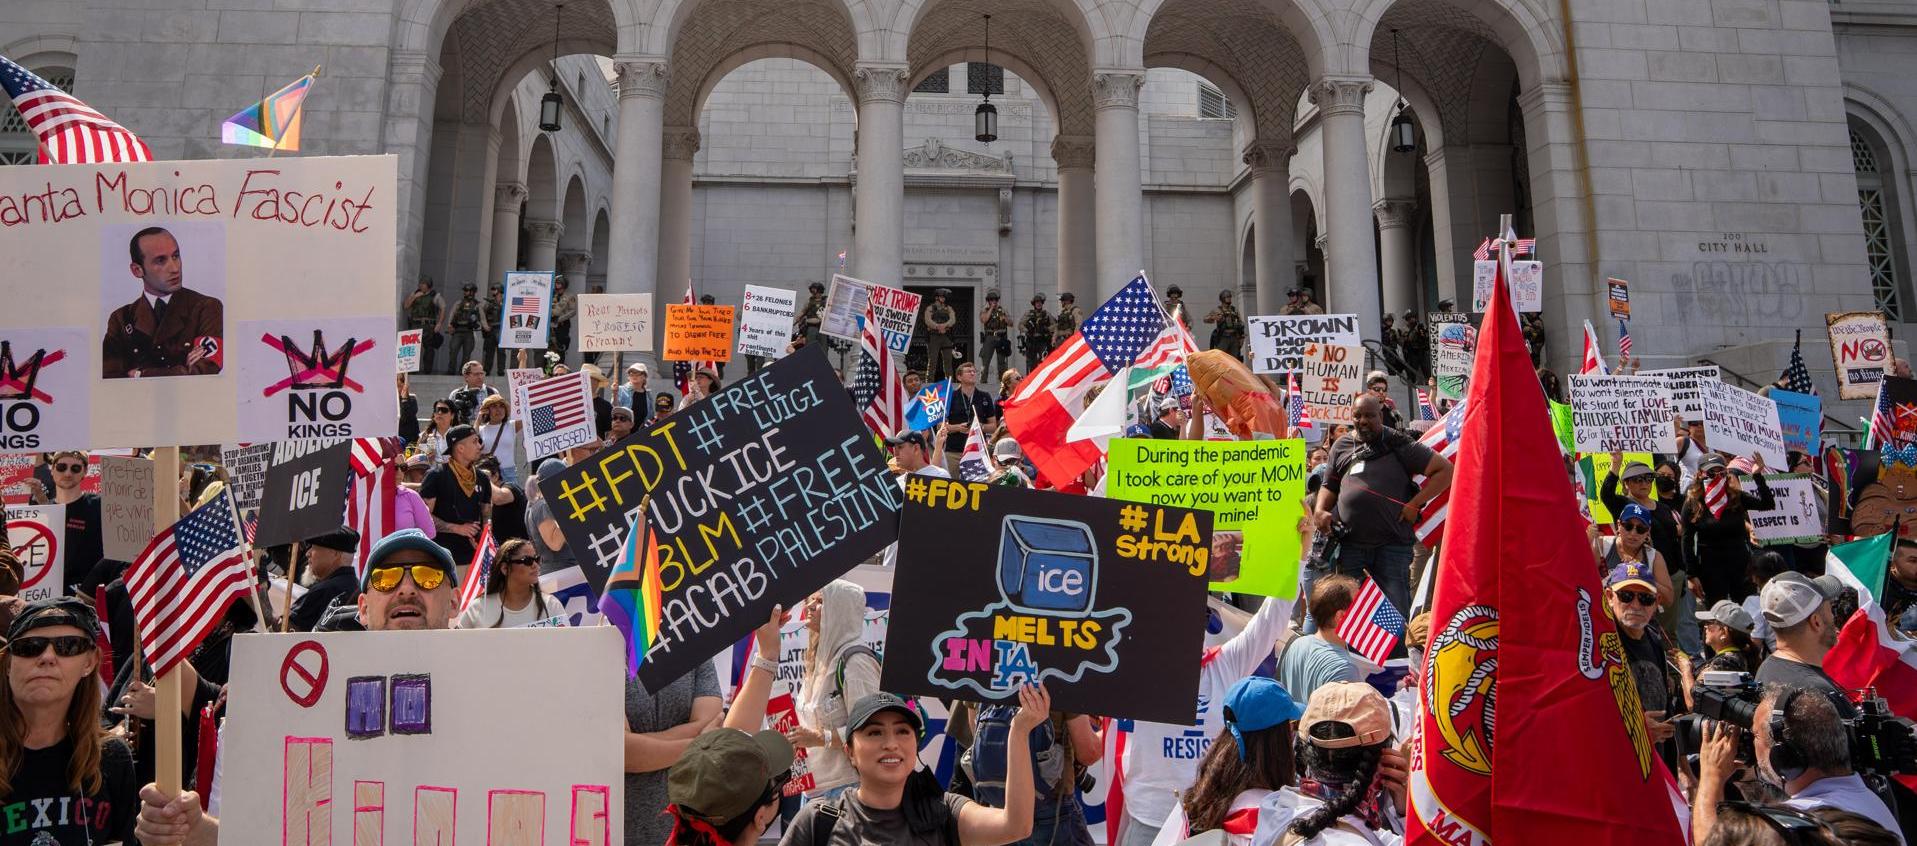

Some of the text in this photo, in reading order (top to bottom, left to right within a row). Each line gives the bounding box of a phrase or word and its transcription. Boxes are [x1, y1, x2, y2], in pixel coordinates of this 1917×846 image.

[0, 170, 375, 234] anta Monica Fascist
[1698, 242, 1768, 253] CITY HALL
[744, 303, 751, 311] 6
[764, 296, 793, 306] FELONIES
[885, 308, 912, 324] SWORE
[742, 323, 748, 333] 4
[880, 318, 912, 334] PROTECT
[739, 344, 746, 352] 7
[1322, 345, 1347, 363] NO
[1306, 361, 1359, 379] HUMAN
[1322, 378, 1340, 392] IS
[1570, 375, 1588, 388] You
[1670, 380, 1698, 390] LIBER
[1304, 391, 1355, 406] ILLEGA
[1570, 389, 1585, 399] You
[1671, 391, 1700, 401] JUSTI
[288, 391, 352, 423] NO
[752, 379, 824, 430] LUIGI
[1571, 398, 1588, 411] We
[1623, 399, 1638, 409] for
[0, 402, 40, 433] O
[688, 371, 784, 456] #FREE
[288, 423, 352, 439] KINGS
[1614, 424, 1657, 440] FUTURE
[1659, 425, 1668, 438] of
[1704, 408, 1727, 425] LOVE
[1729, 415, 1741, 429] IT
[1758, 424, 1782, 442] MUCH
[0, 434, 40, 449] NGS
[534, 424, 592, 458] DISTRESSED!
[1600, 439, 1660, 452] AMERICA
[224, 449, 239, 460] STOP
[1137, 444, 1290, 467] During the pandemic
[225, 459, 237, 468] STOP
[235, 463, 262, 475] FAMILIES
[241, 472, 265, 483] TOGETH
[558, 421, 688, 523] #FDT
[1117, 463, 1304, 488] I took care of your MOM
[289, 467, 322, 511] ICE
[737, 434, 877, 534] #FREE
[1770, 486, 1790, 498] ONLY
[243, 491, 256, 500] AND
[906, 478, 989, 511] #FDT
[1151, 488, 1281, 508] now you want to
[1633, 504, 1642, 515] LA
[1779, 500, 1784, 511] I
[1219, 506, 1259, 523] mine!
[1753, 515, 1799, 528] RESPECT IS
[756, 468, 904, 580] PALESTINE
[1116, 533, 1209, 577] Strong
[1037, 564, 1084, 595] ice
[1579, 602, 1591, 637] FIDELIS
[993, 615, 1101, 650] MELTS
[1581, 637, 1591, 672] SEMPER
[943, 637, 1041, 690] IN LA
[1163, 737, 1213, 760] RESIS
[3, 797, 112, 834] EXICO
